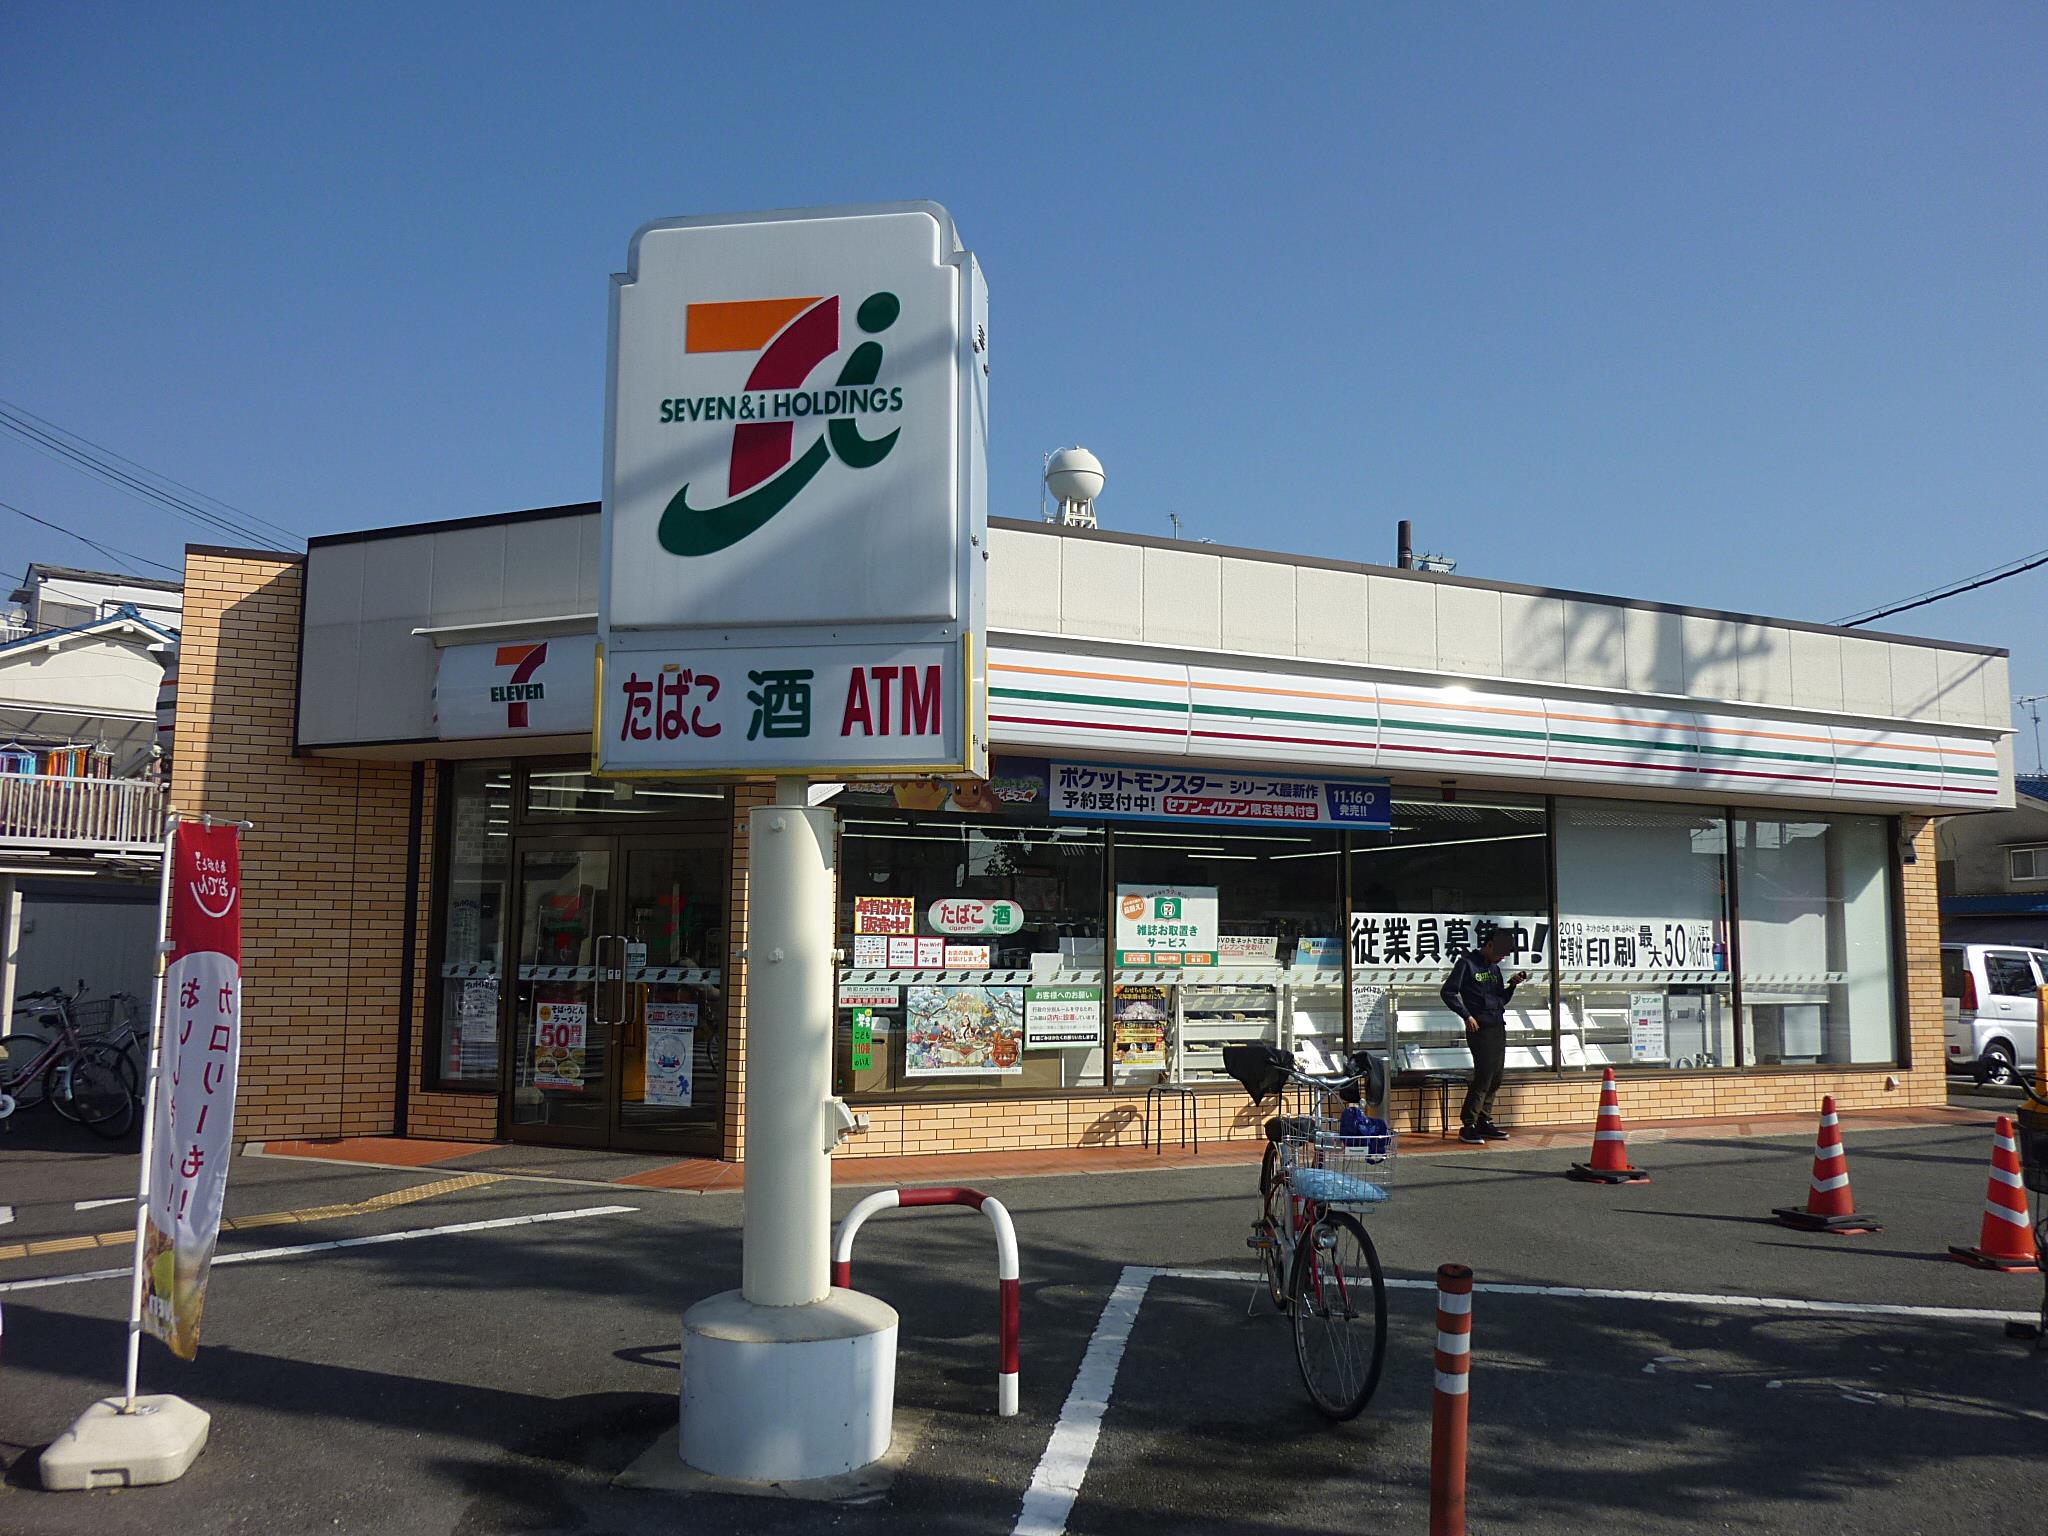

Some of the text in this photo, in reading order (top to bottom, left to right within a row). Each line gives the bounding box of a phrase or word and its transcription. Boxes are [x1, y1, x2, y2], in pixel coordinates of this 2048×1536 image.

[773, 386, 903, 418] HOLDINGS
[621, 665, 942, 741] たばこ 酒 ATM
[1059, 767, 1319, 800] ポケットモンスター シリーズ最新作
[1062, 790, 1156, 813] 予約受付中!
[1339, 804, 1368, 817] 発売!!
[856, 898, 913, 916] 年賀はがき
[940, 904, 1011, 925] たばこ 酒
[861, 916, 911, 934] 販売中!
[1137, 924, 1199, 937] 雑誌お取置き
[1559, 922, 1583, 936] 2019
[1147, 938, 1188, 948] サービス
[1559, 936, 1636, 967] 年賀状 印刷
[1036, 991, 1093, 1000] お客様へのお願い
[552, 1005, 585, 1014] そば・うどん
[553, 1014, 582, 1023] ラーメン
[855, 1031, 871, 1040] こども
[854, 1057, 870, 1066] のいえ
